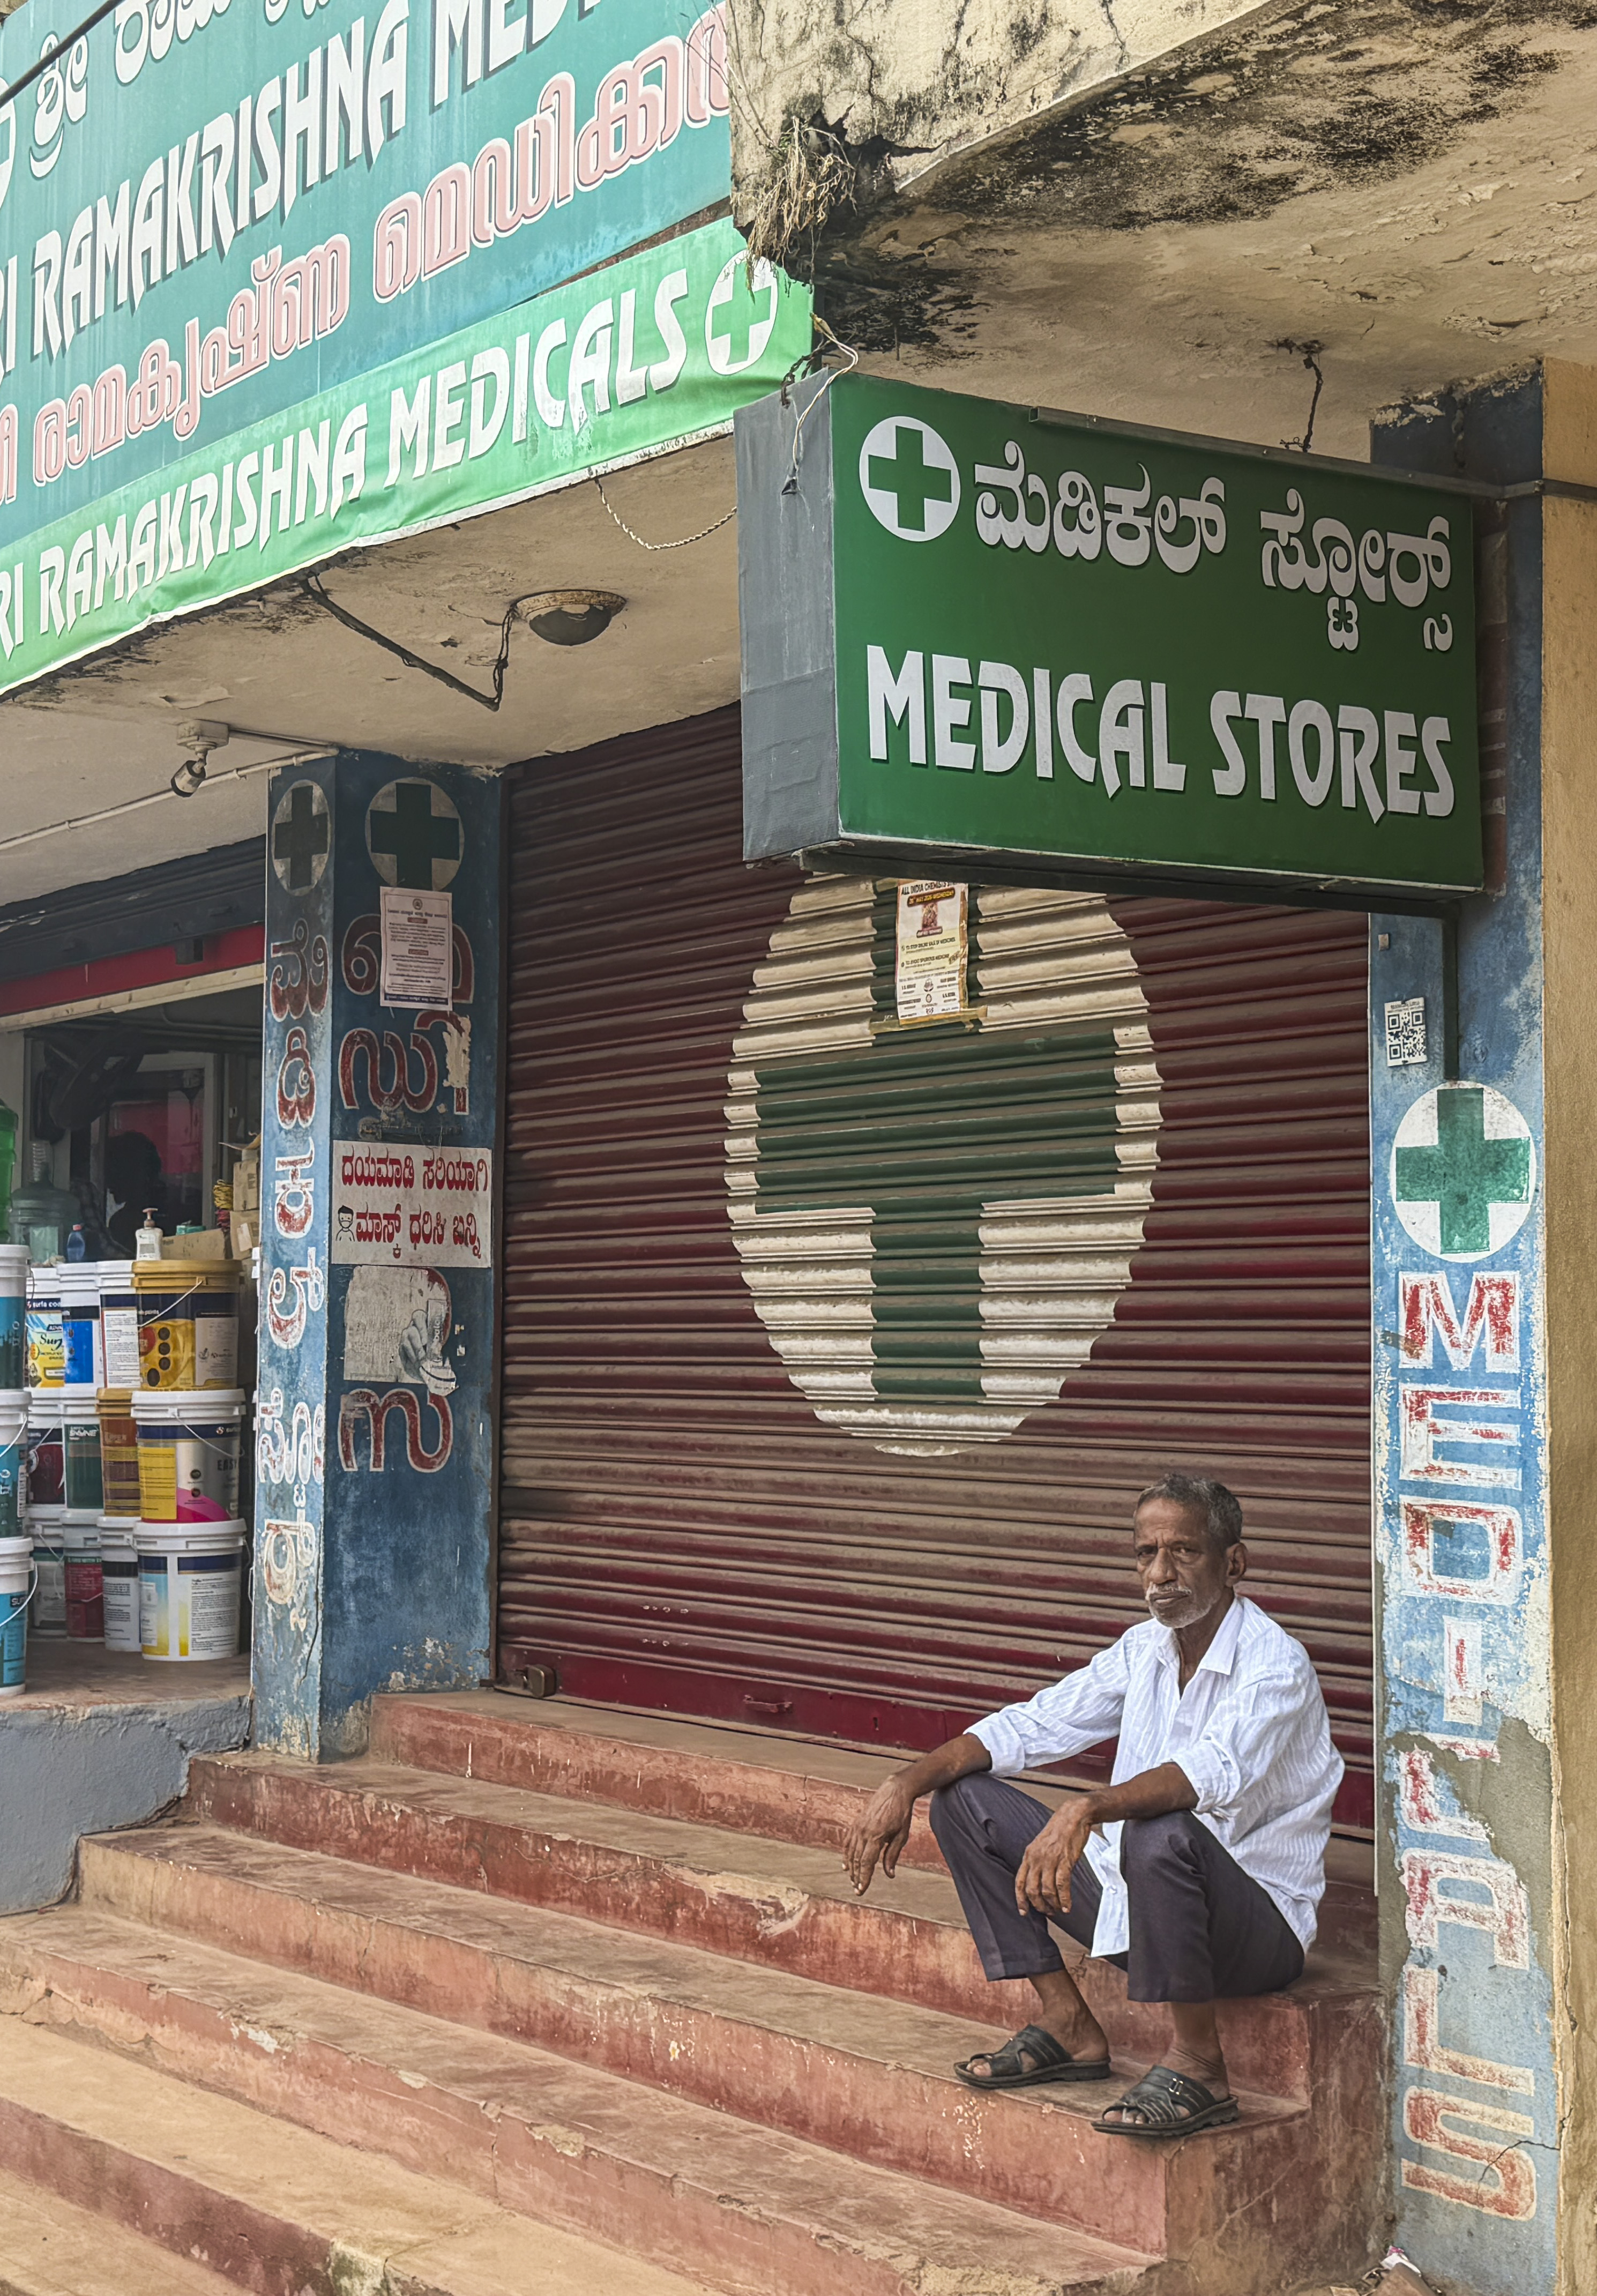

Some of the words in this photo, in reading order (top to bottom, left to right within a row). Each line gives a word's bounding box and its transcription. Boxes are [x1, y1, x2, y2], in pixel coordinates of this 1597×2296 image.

[33, 0, 409, 360] RAMAKRISHNA
[39, 402, 369, 637] RAMAKRISHNA
[383, 268, 689, 490] MEDICALS
[974, 441, 1227, 573] ಮೆಡಿಕಲ್
[867, 645, 1186, 799] MEDICAL
[1210, 690, 1455, 825] STORES
